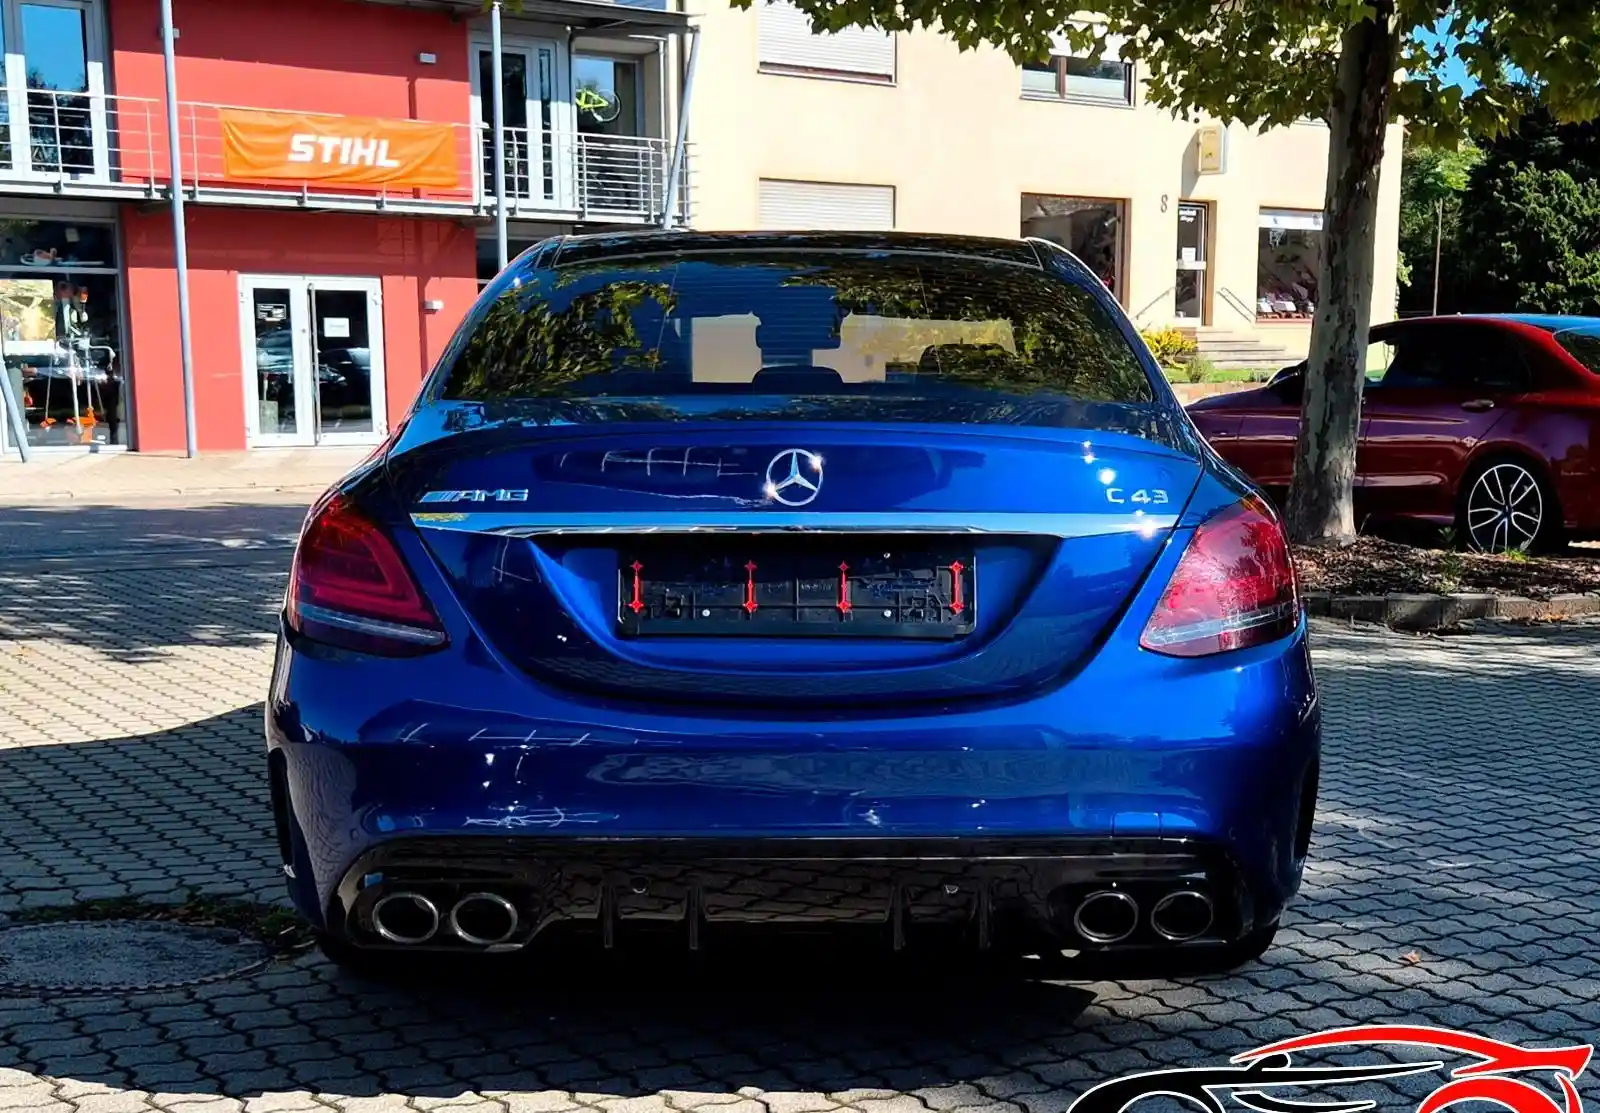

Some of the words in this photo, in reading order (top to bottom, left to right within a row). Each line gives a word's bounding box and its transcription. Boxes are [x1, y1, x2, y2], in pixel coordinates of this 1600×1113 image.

[287, 133, 400, 168] STIHL
[1160, 194, 1168, 213] 8
[1106, 488, 1125, 504] C
[1131, 489, 1169, 504] 43
